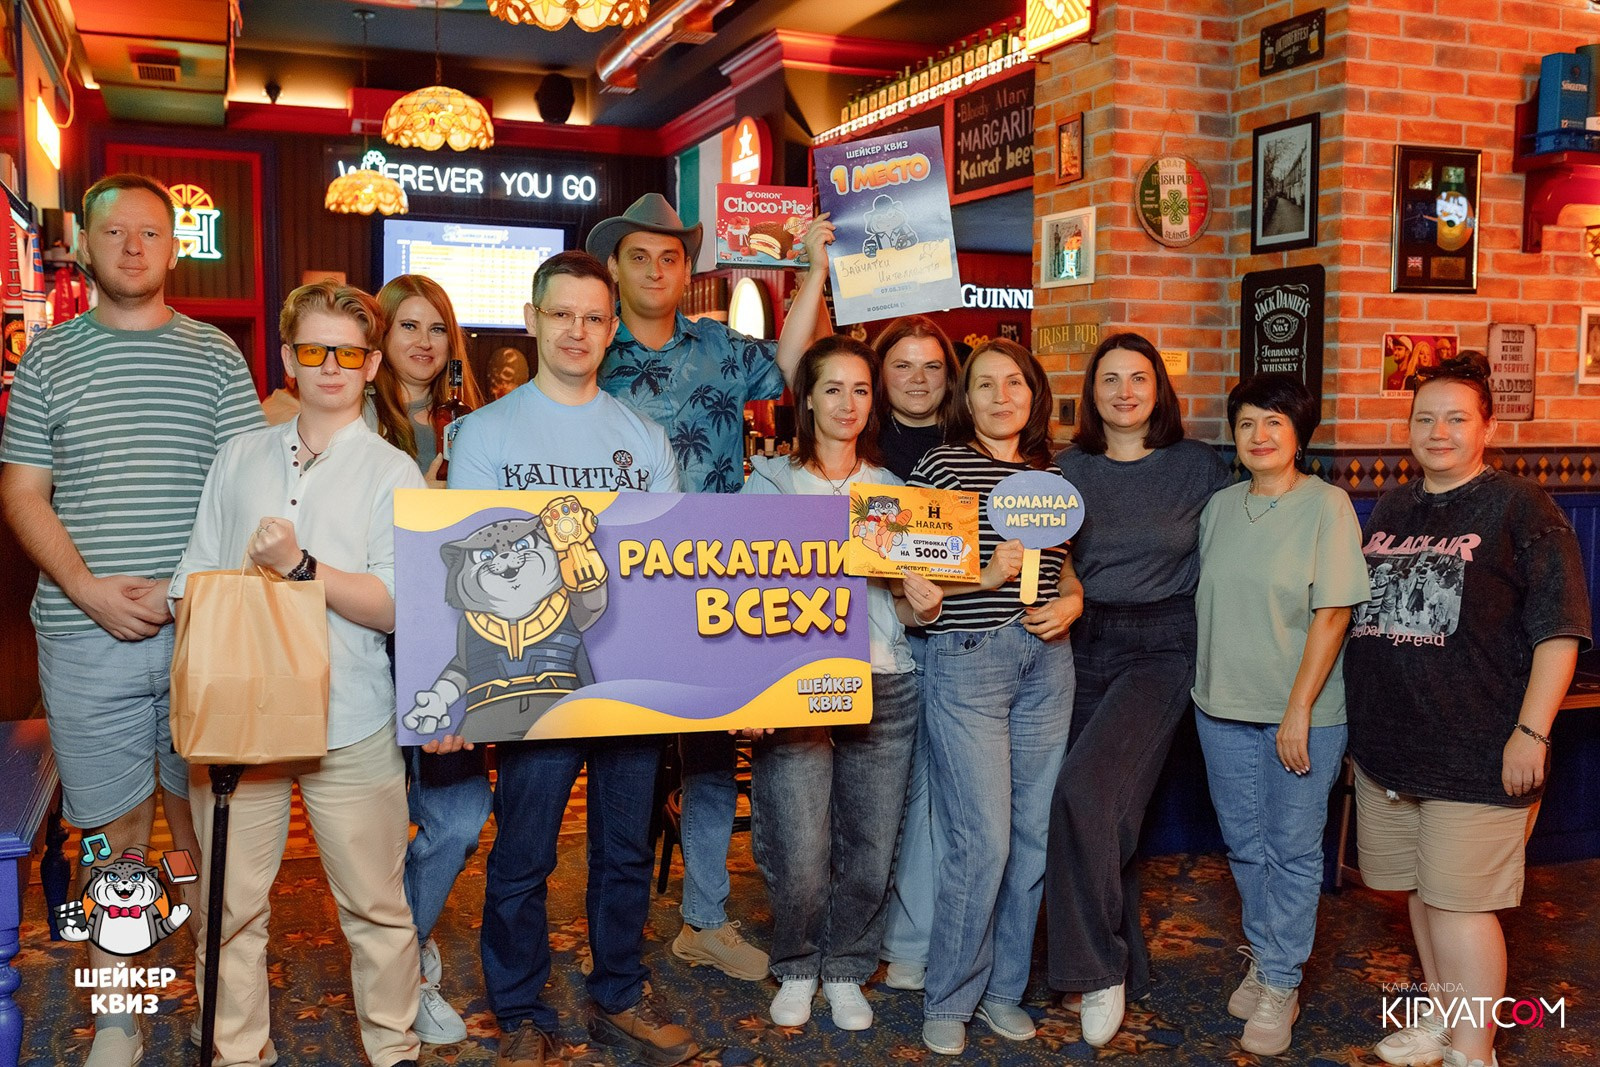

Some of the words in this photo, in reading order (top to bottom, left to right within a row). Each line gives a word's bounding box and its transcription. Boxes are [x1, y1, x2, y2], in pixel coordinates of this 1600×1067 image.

[960, 105, 1034, 154] MARGARIT
[845, 145, 882, 159] ШЕЙКЕР
[883, 140, 908, 152] КВИЗ
[830, 165, 849, 195] 1
[851, 153, 931, 193] МЕСТО
[960, 147, 1002, 185] Kairat
[338, 160, 484, 194] EREVER
[500, 171, 552, 199] YOU
[562, 174, 597, 201] GO
[1151, 173, 1176, 186] IRISH
[1176, 173, 1194, 186] PUB
[1254, 295, 1276, 322] JACK
[1275, 289, 1311, 318] DANIEL'S
[1038, 325, 1070, 349] IRISH
[1074, 323, 1098, 346] PUB
[1261, 345, 1300, 357] Tennessee
[1262, 362, 1299, 373] WHISKEY
[1504, 363, 1530, 373] SERVICE
[1506, 403, 1530, 414] DRINKS
[993, 494, 1079, 510] КОМАНДА
[1005, 512, 1066, 527] МЕЧТЫ
[914, 547, 948, 560] 5000
[1362, 531, 1435, 556] BLACK
[1433, 533, 1482, 562] AIR
[618, 538, 850, 579] РАСКАТАЛИ
[695, 586, 851, 638] ВСЕХ!
[797, 674, 863, 695] ШЕЙКЕР
[808, 696, 853, 713] КВИЗ
